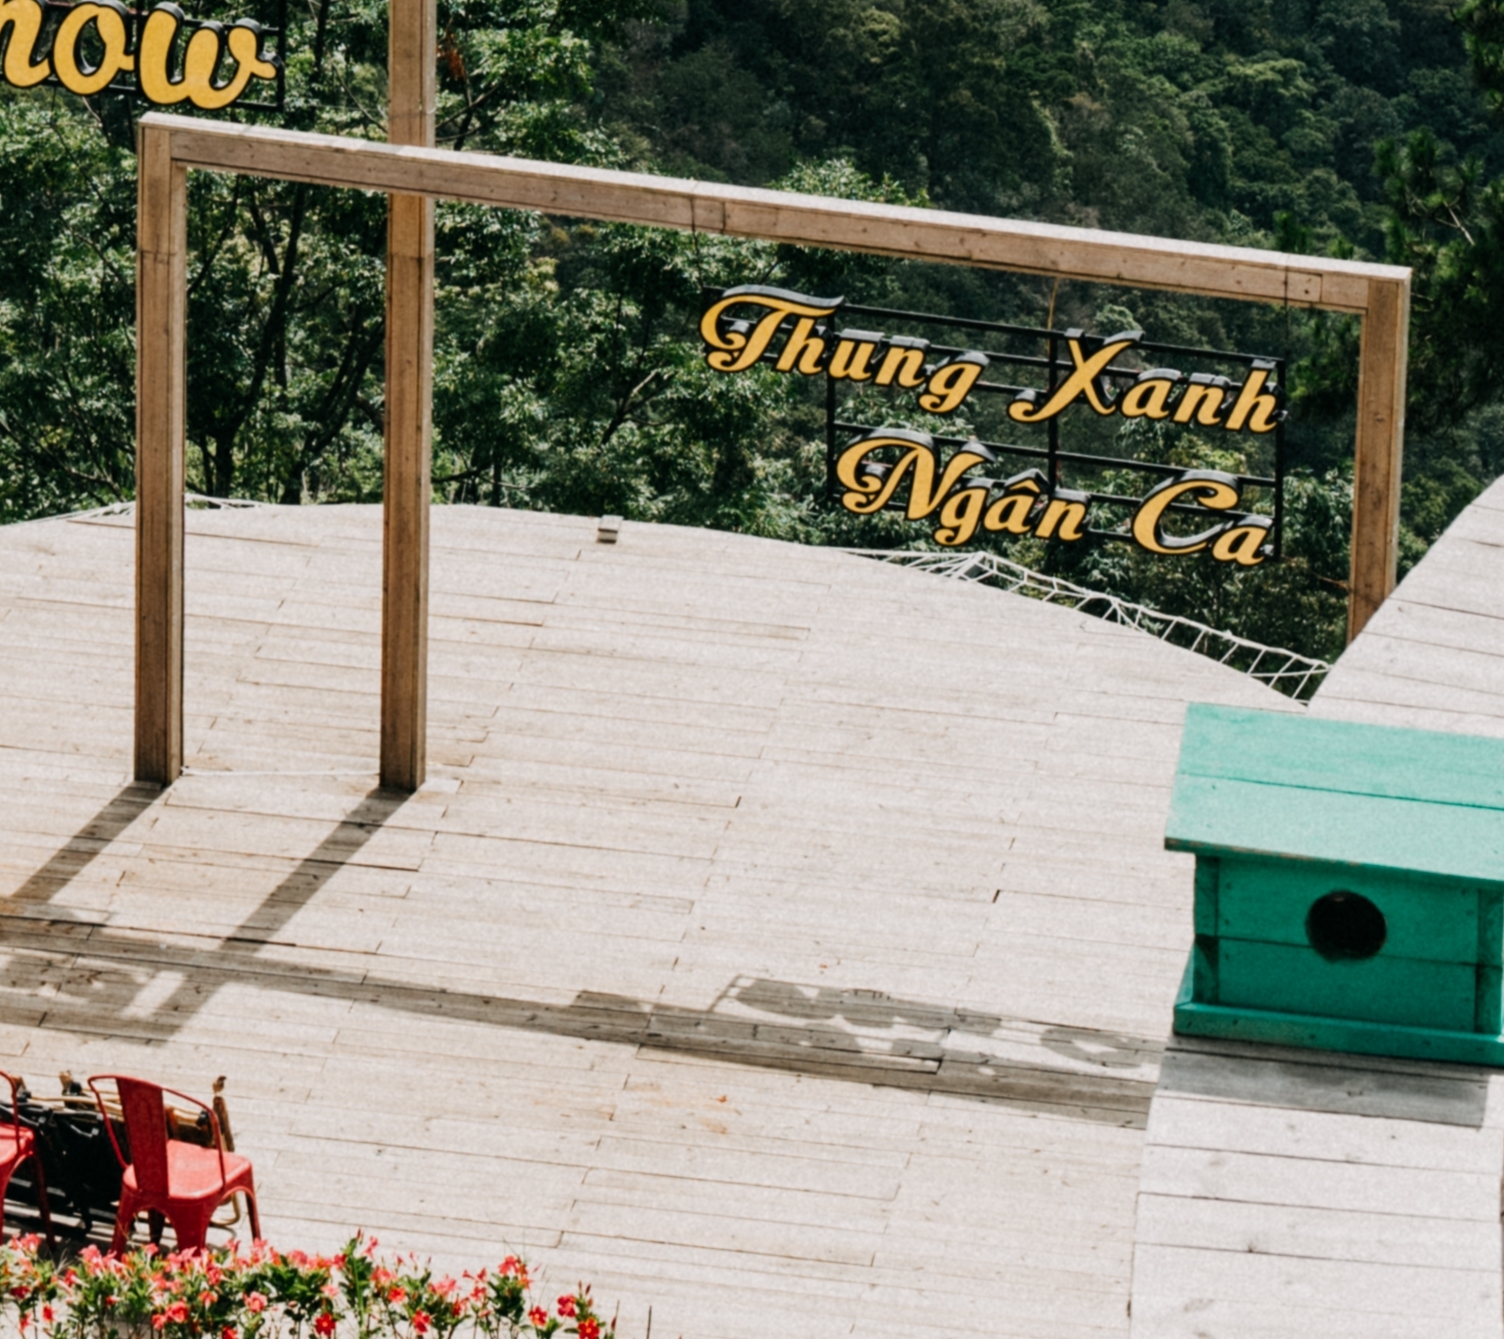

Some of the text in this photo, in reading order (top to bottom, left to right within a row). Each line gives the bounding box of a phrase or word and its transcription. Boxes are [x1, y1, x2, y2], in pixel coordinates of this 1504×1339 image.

[700, 291, 1278, 433] Thung Xanh
[836, 437, 1269, 567] Ngân Ca
